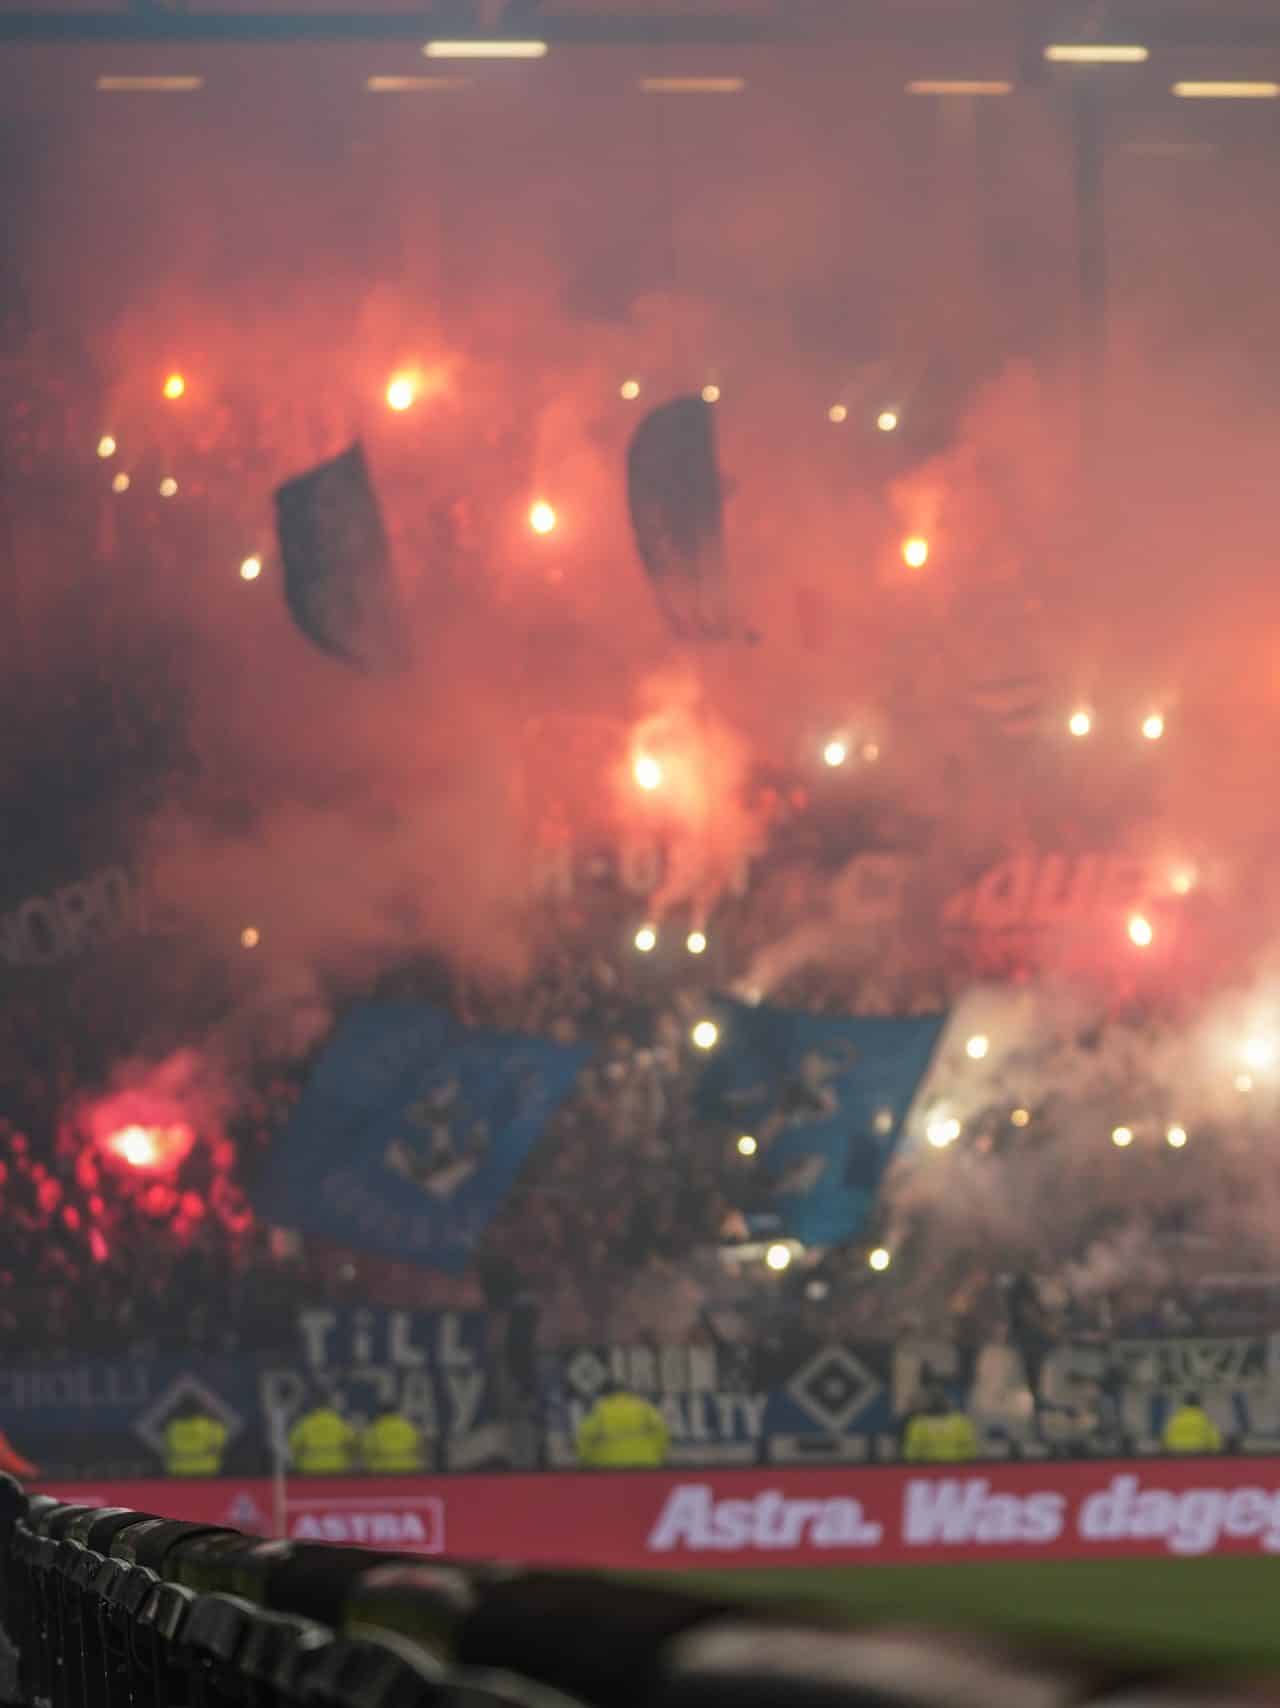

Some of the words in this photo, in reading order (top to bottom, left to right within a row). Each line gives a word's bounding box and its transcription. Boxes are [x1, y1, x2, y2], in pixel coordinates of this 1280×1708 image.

[293, 1512, 426, 1543] ASTRA
[651, 1485, 882, 1549] Astra.
[903, 1479, 1063, 1543] Was
